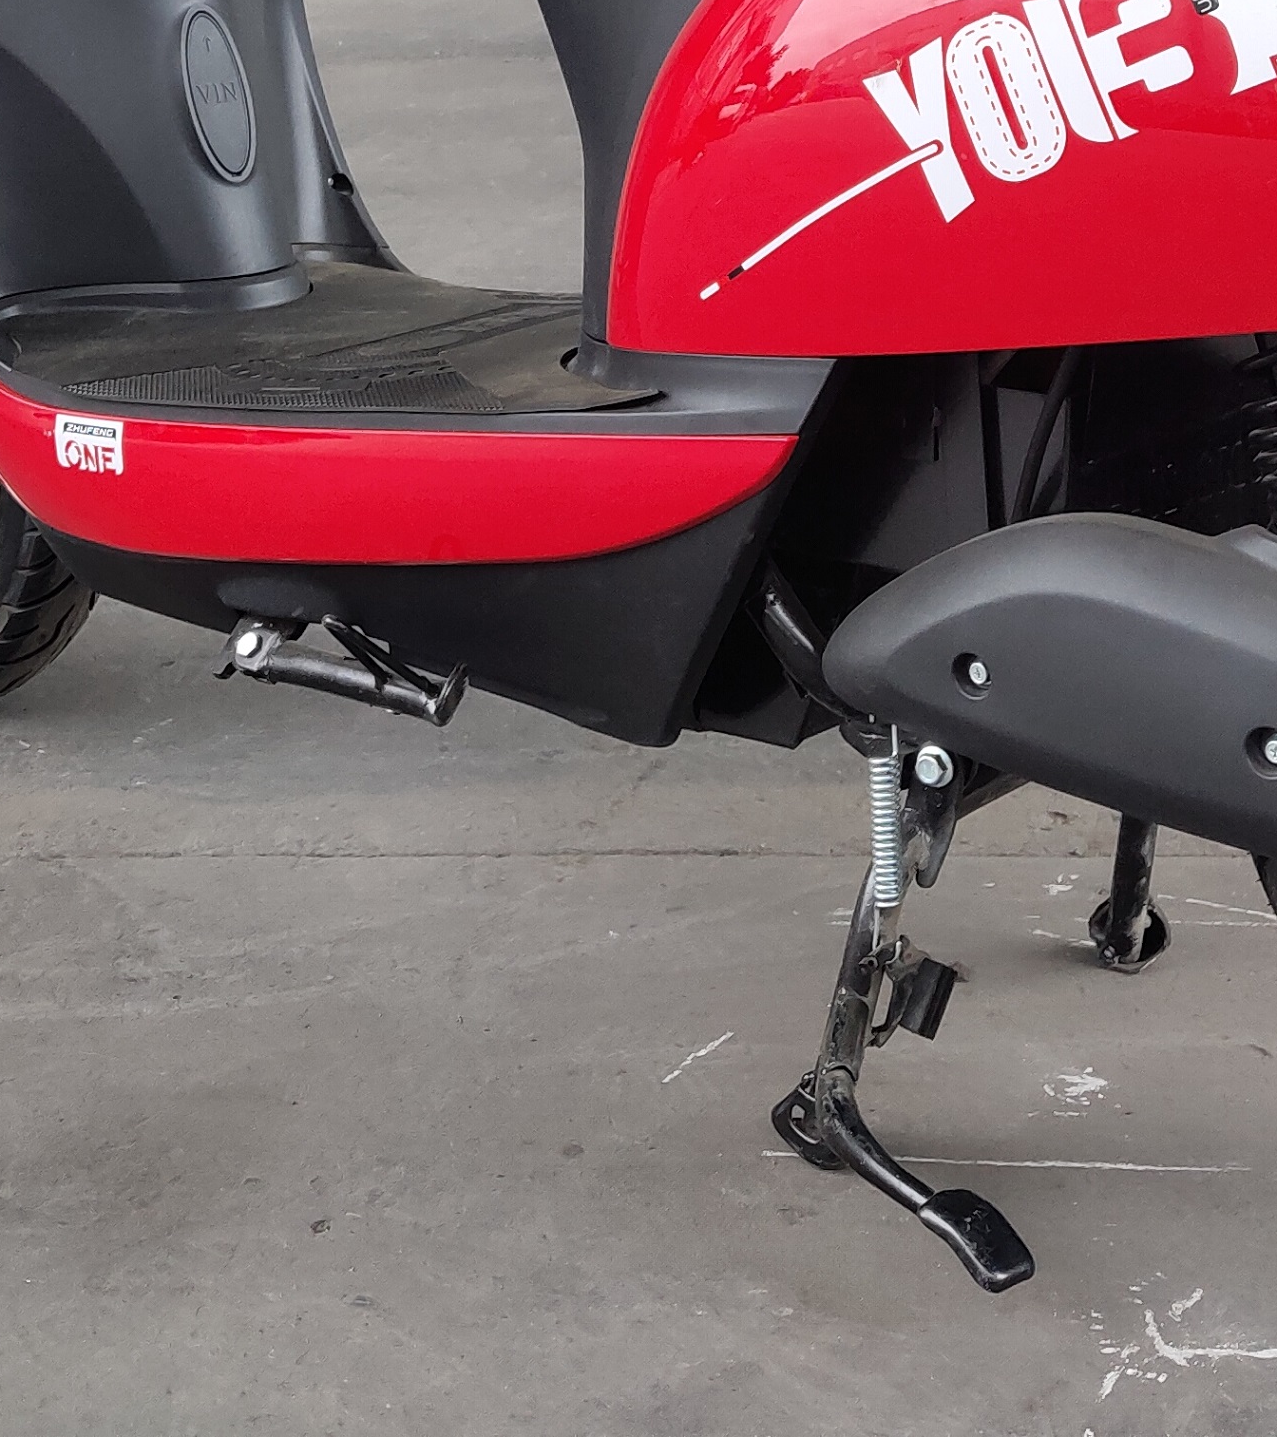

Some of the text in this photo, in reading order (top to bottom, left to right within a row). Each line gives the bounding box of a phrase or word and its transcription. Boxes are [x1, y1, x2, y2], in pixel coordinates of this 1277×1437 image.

[196, 82, 238, 104] VIN
[65, 423, 114, 437] ZHUFENG
[65, 440, 115, 473] ONE
